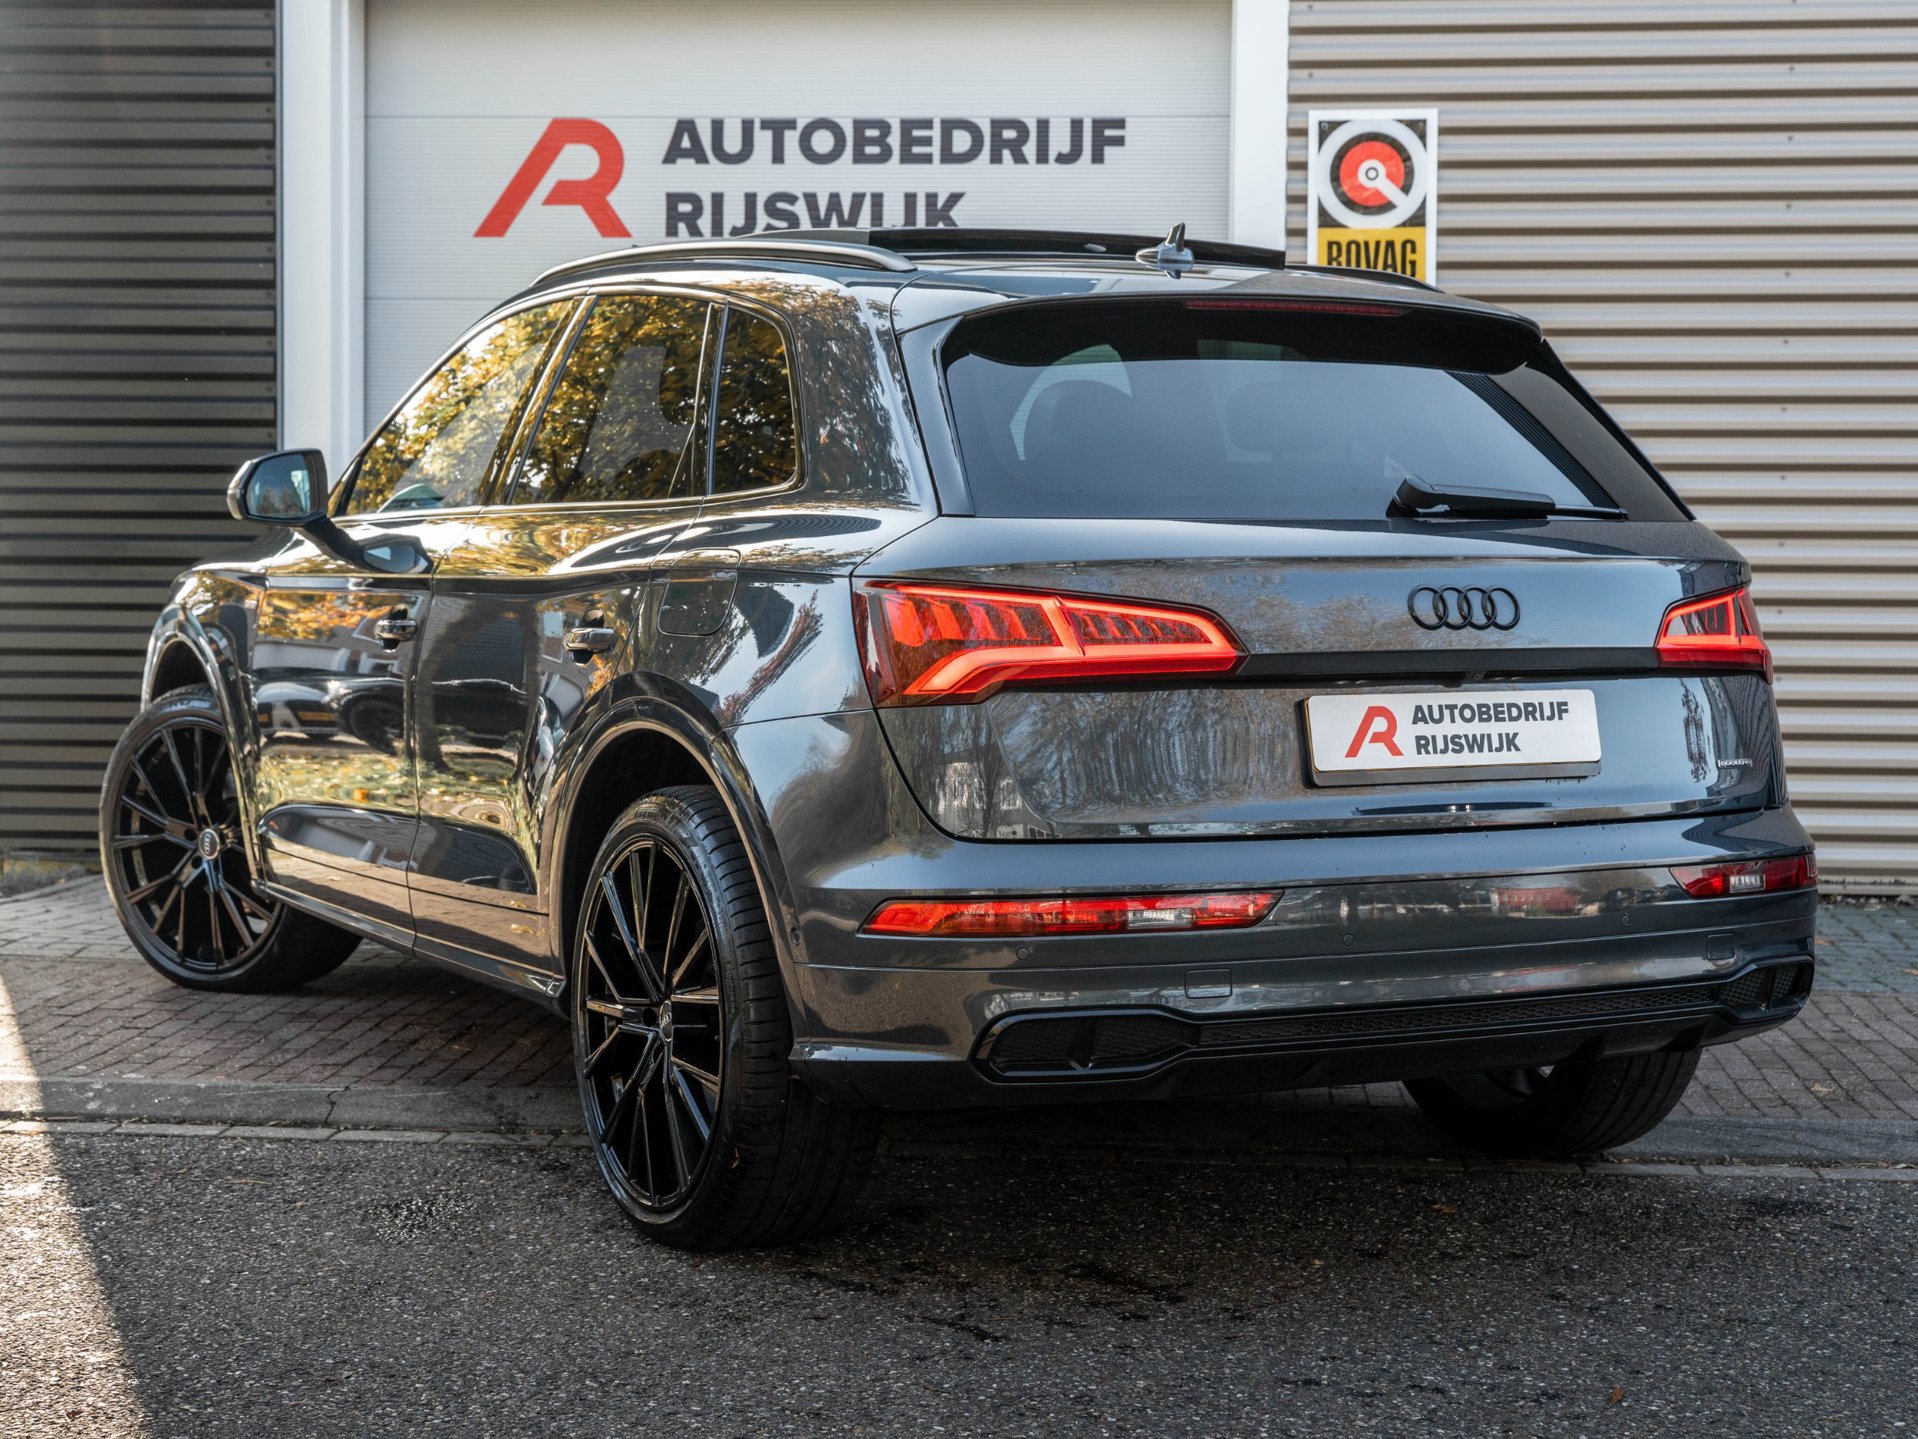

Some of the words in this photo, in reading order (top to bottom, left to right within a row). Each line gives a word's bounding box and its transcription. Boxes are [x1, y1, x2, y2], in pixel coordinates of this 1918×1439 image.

[662, 118, 1127, 165] AUTOBEDRIJF
[665, 191, 967, 238] RIJSWIJK
[1326, 239, 1417, 278] BOVAG
[1411, 701, 1569, 725] AUTOBEDRIJF
[1415, 732, 1522, 755] RIJSWIJK
